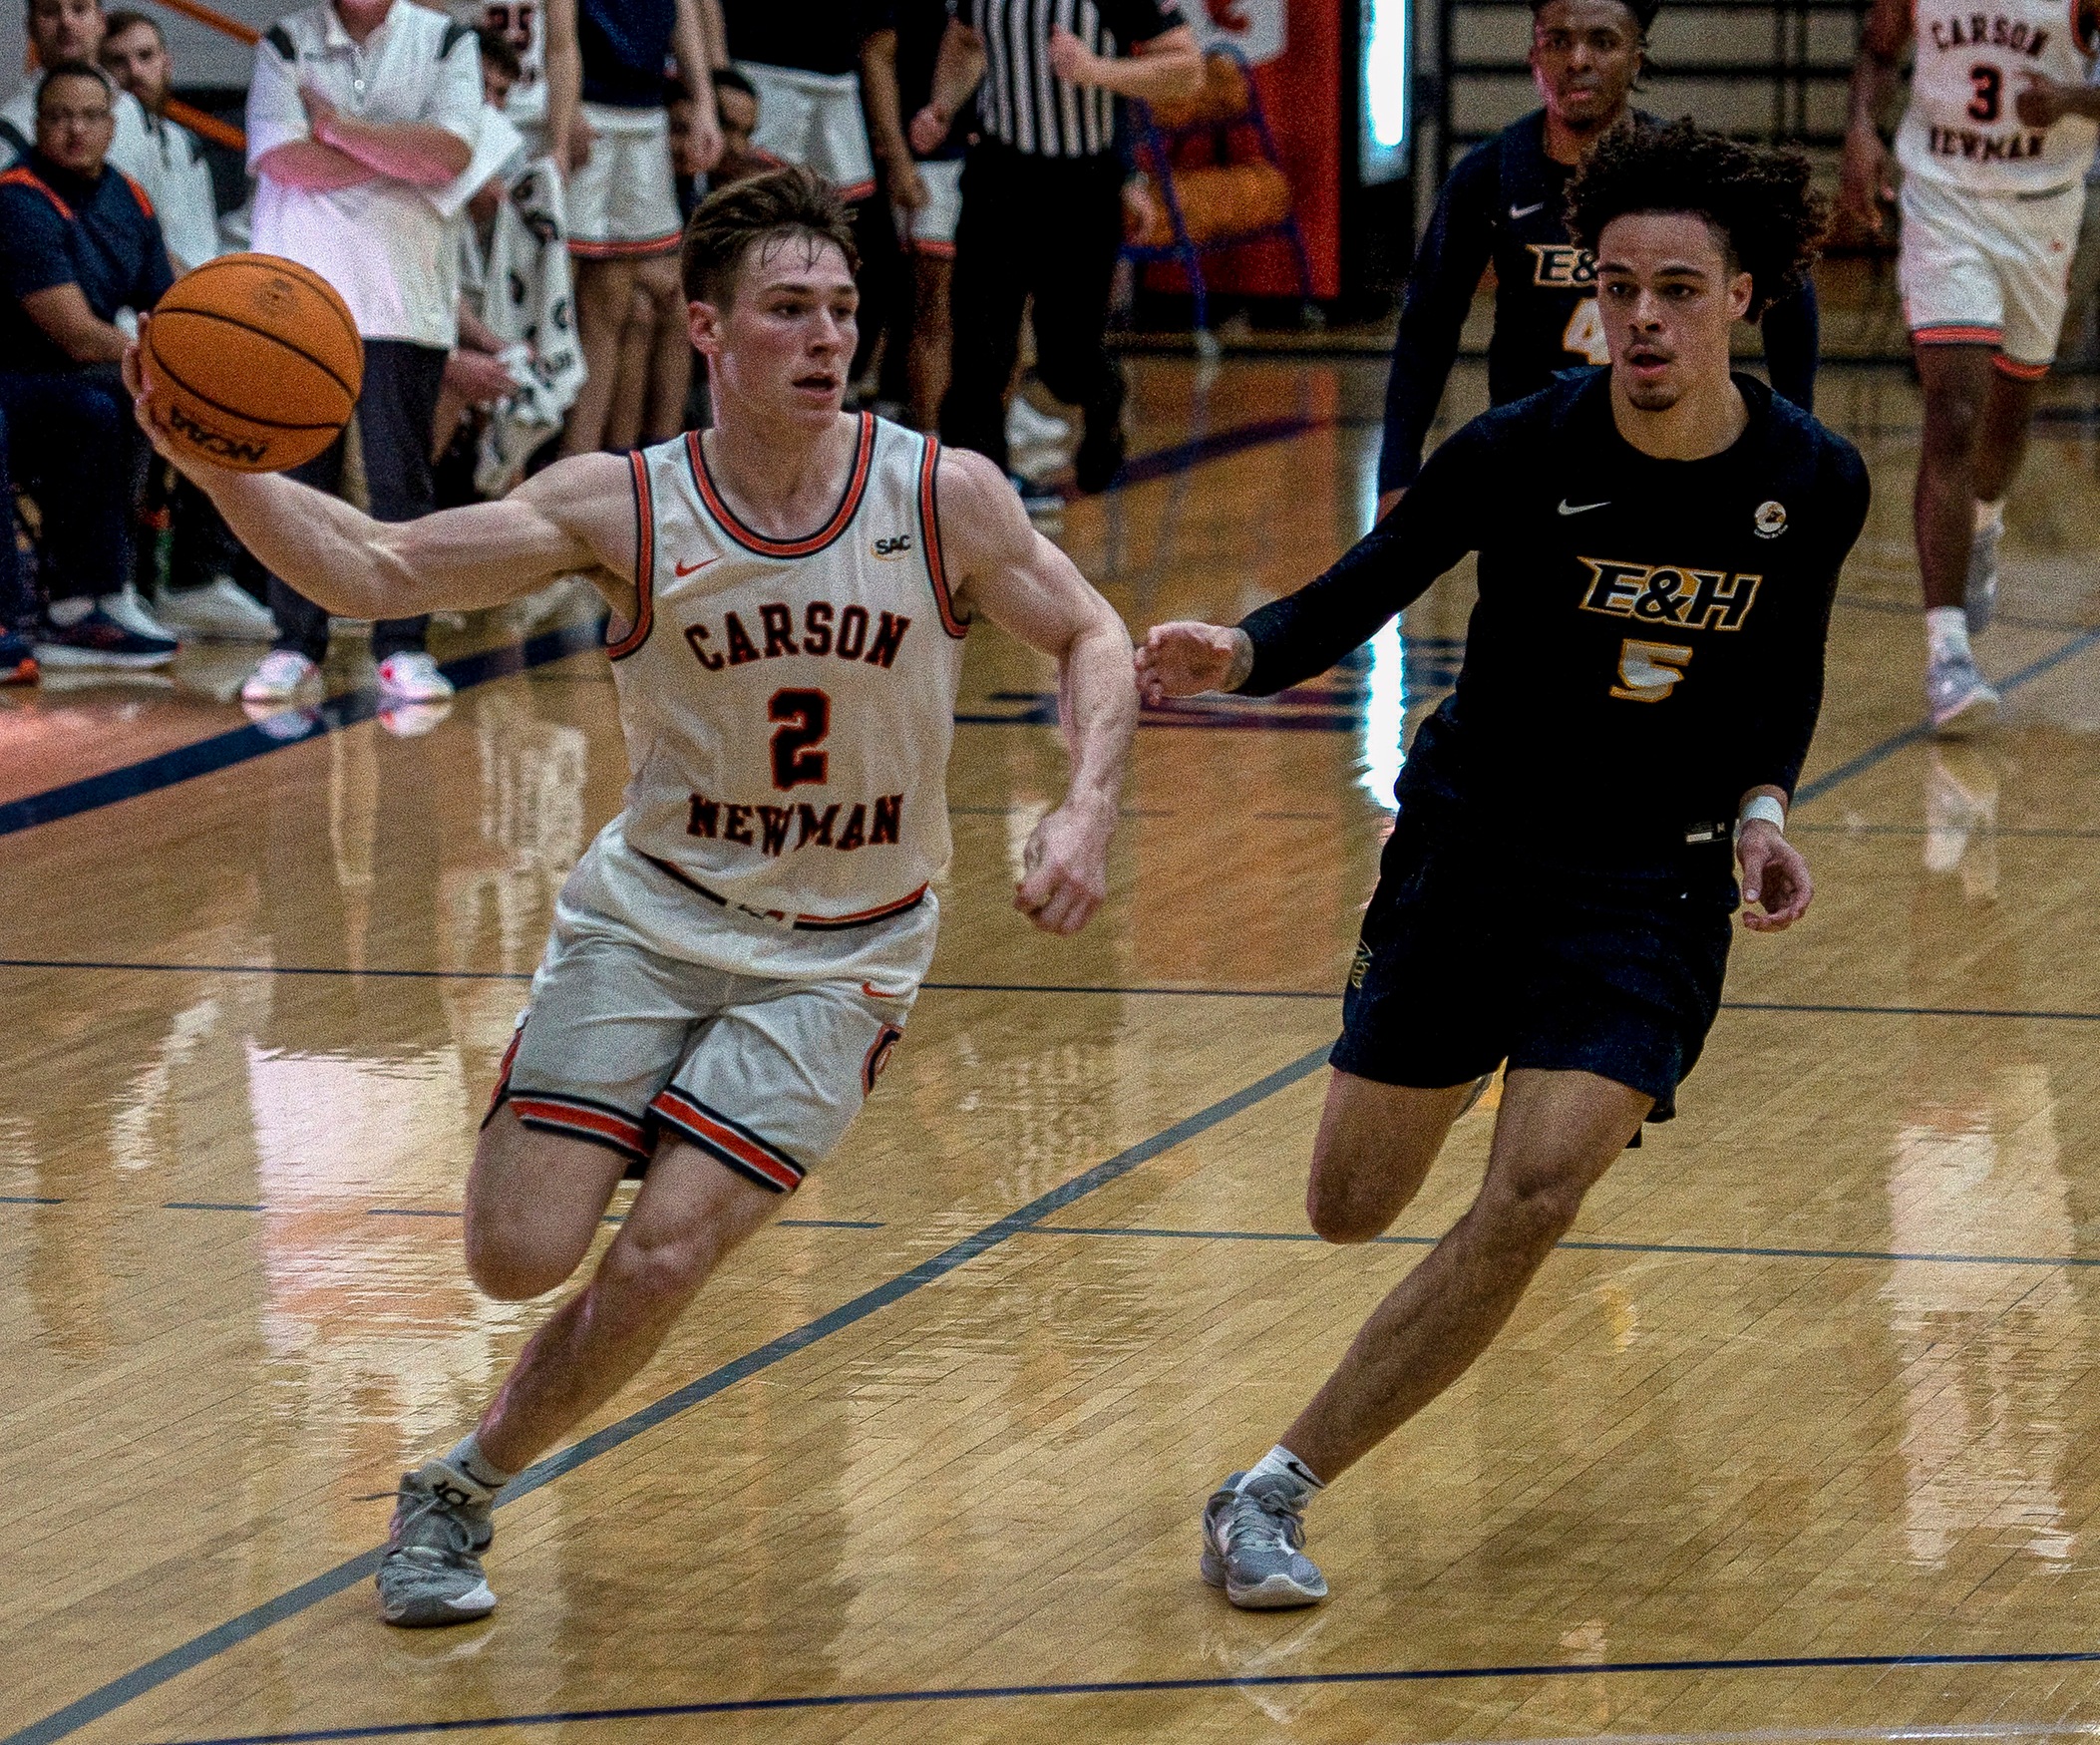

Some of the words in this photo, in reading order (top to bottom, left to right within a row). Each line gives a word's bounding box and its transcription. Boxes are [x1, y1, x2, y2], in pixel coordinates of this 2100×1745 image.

[1931, 14, 2048, 55] CARSON
[1967, 63, 2002, 123] 3
[1928, 126, 2042, 162] NEWMAN
[1526, 244, 1596, 287] E&
[1562, 297, 1612, 365] 4
[875, 534, 911, 555] SAC
[1577, 556, 1763, 631] E&H
[684, 601, 911, 670] CARSON
[1608, 638, 1693, 703] 5
[768, 686, 832, 790] 2
[686, 793, 903, 857] NEWMAN
